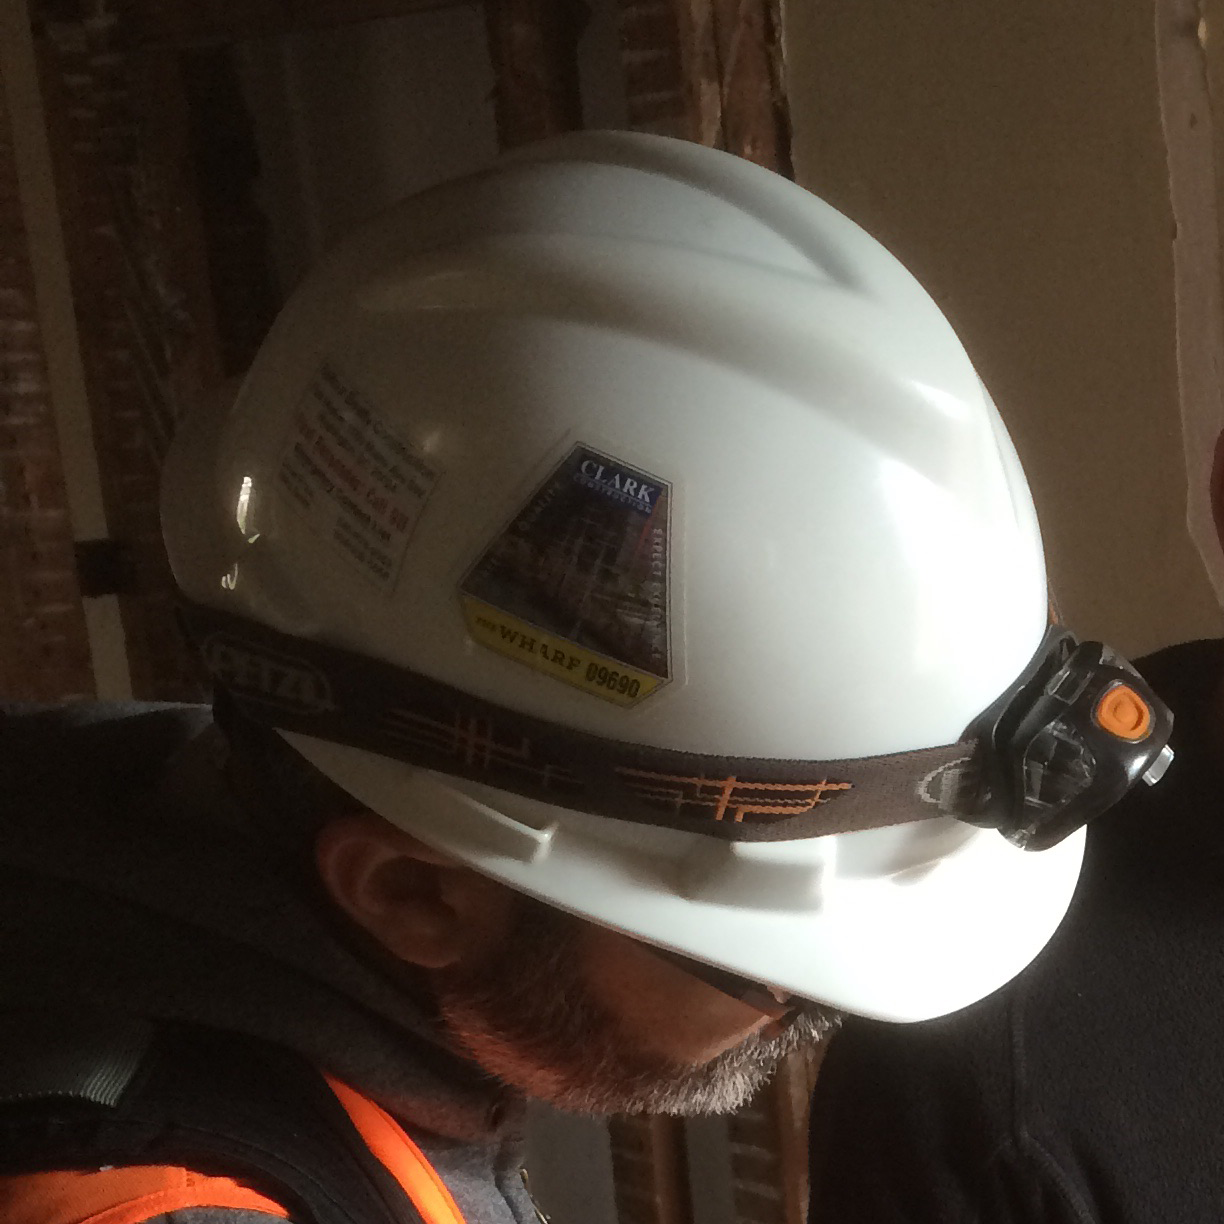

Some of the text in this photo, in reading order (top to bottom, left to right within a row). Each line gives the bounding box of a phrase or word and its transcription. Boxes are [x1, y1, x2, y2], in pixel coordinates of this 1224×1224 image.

[580, 459, 654, 502] CLARK
[652, 528, 663, 576] EXPECT
[500, 624, 581, 671] WHARF
[585, 661, 641, 698] 09690
